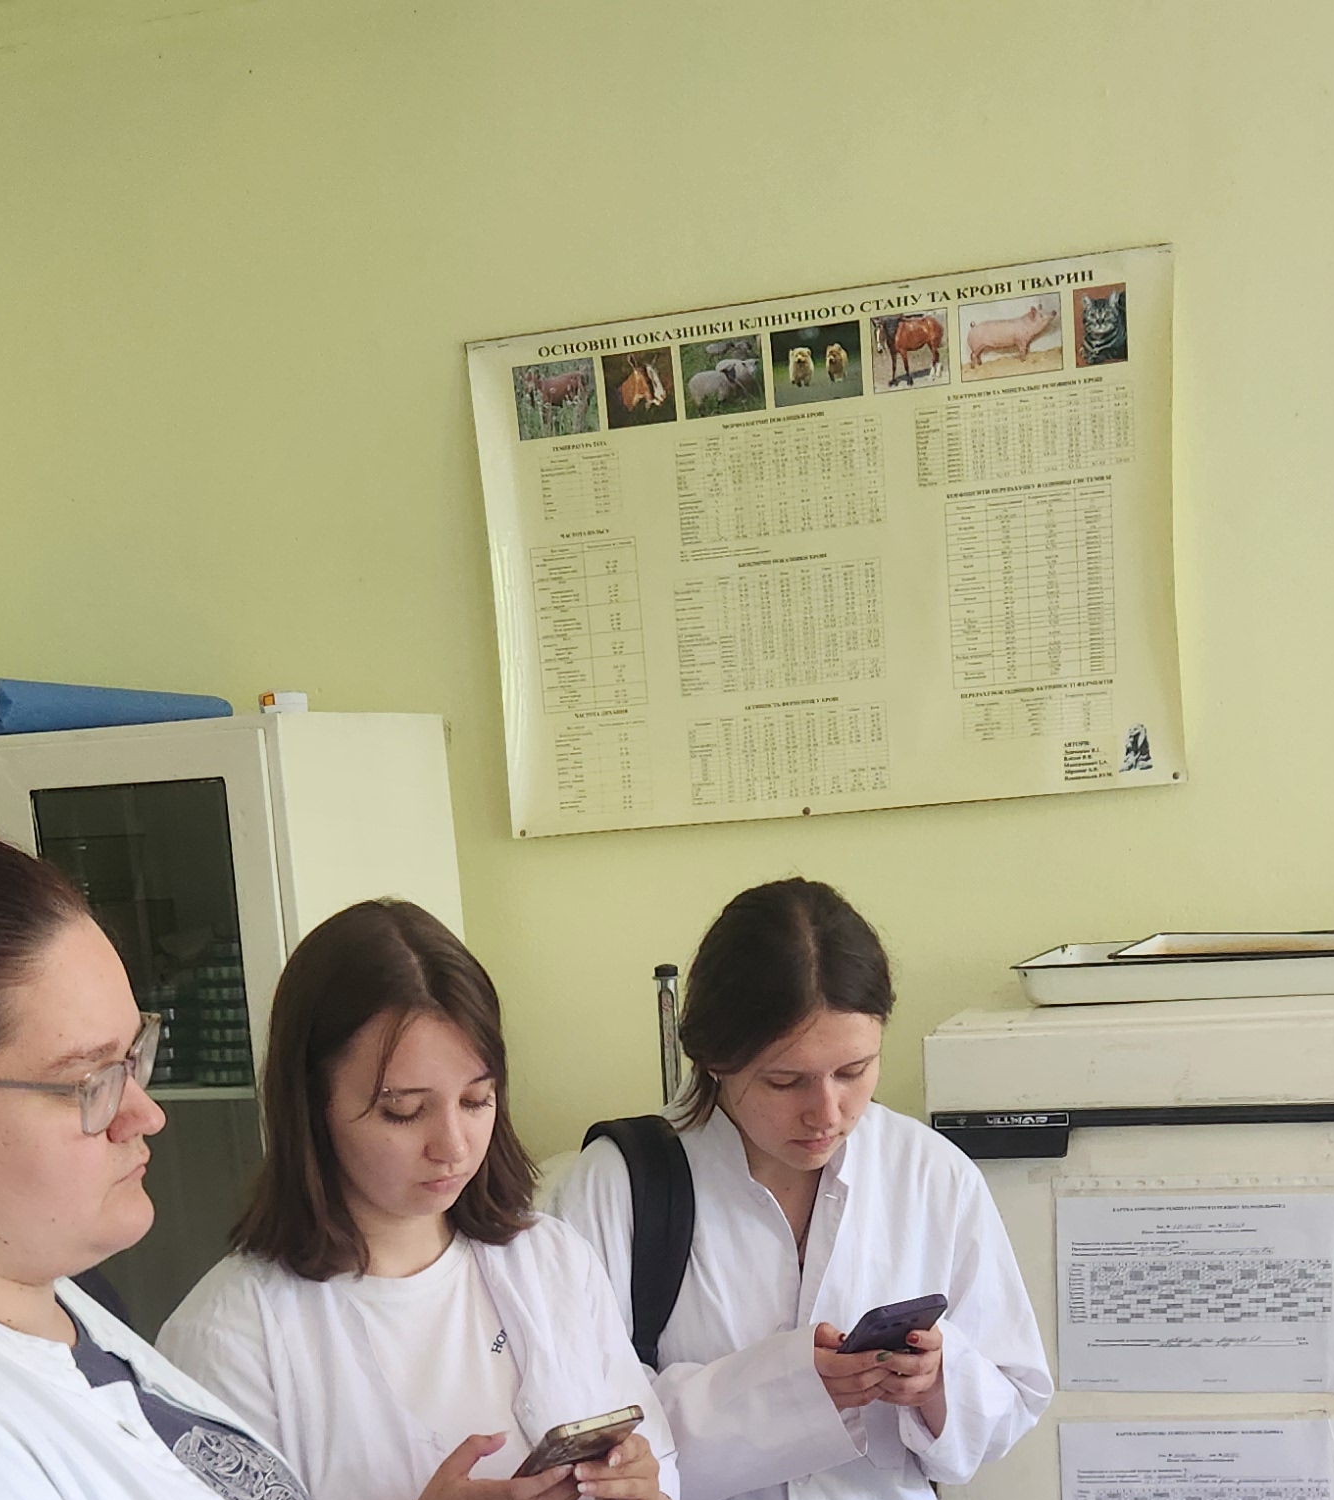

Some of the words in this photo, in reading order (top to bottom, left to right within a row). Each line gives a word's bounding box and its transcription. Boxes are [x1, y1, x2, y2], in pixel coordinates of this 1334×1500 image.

[538, 336, 618, 358] ОСНОВНІ
[623, 320, 734, 347] ПОКАЗНИКИ
[739, 303, 855, 330] КЛІНІЧНОГО
[859, 293, 922, 313] СТАНУ
[926, 290, 951, 303] ТА
[956, 281, 1013, 300] КРОВІ
[1017, 269, 1094, 292] ТВАРИН
